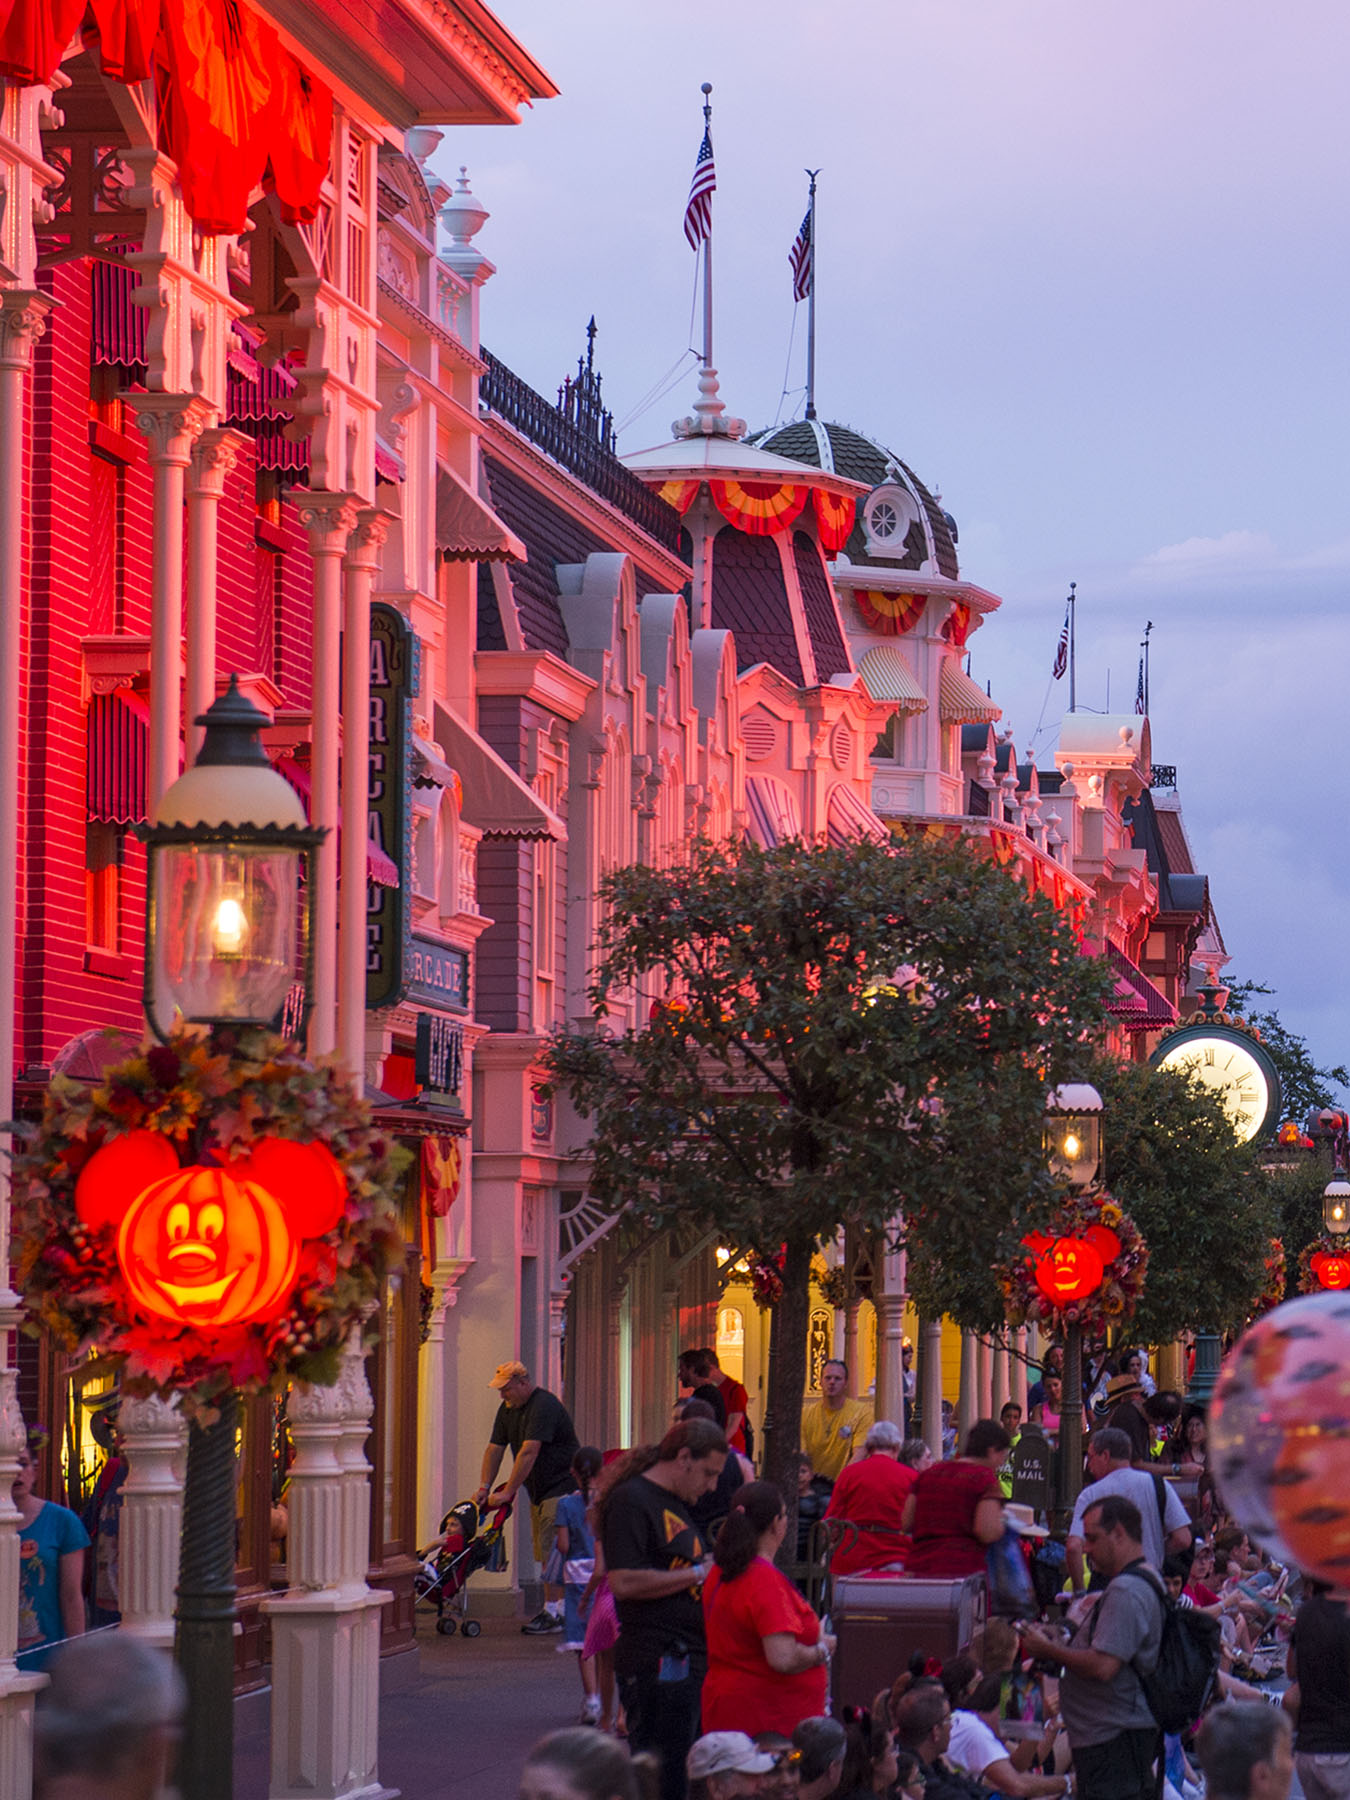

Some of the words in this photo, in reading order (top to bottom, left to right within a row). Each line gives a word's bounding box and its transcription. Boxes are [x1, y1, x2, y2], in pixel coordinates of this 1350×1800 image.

[412, 951, 461, 993] RCADE
[1023, 1459, 1042, 1469] U.S.
[1017, 1470, 1045, 1481] MAIL
